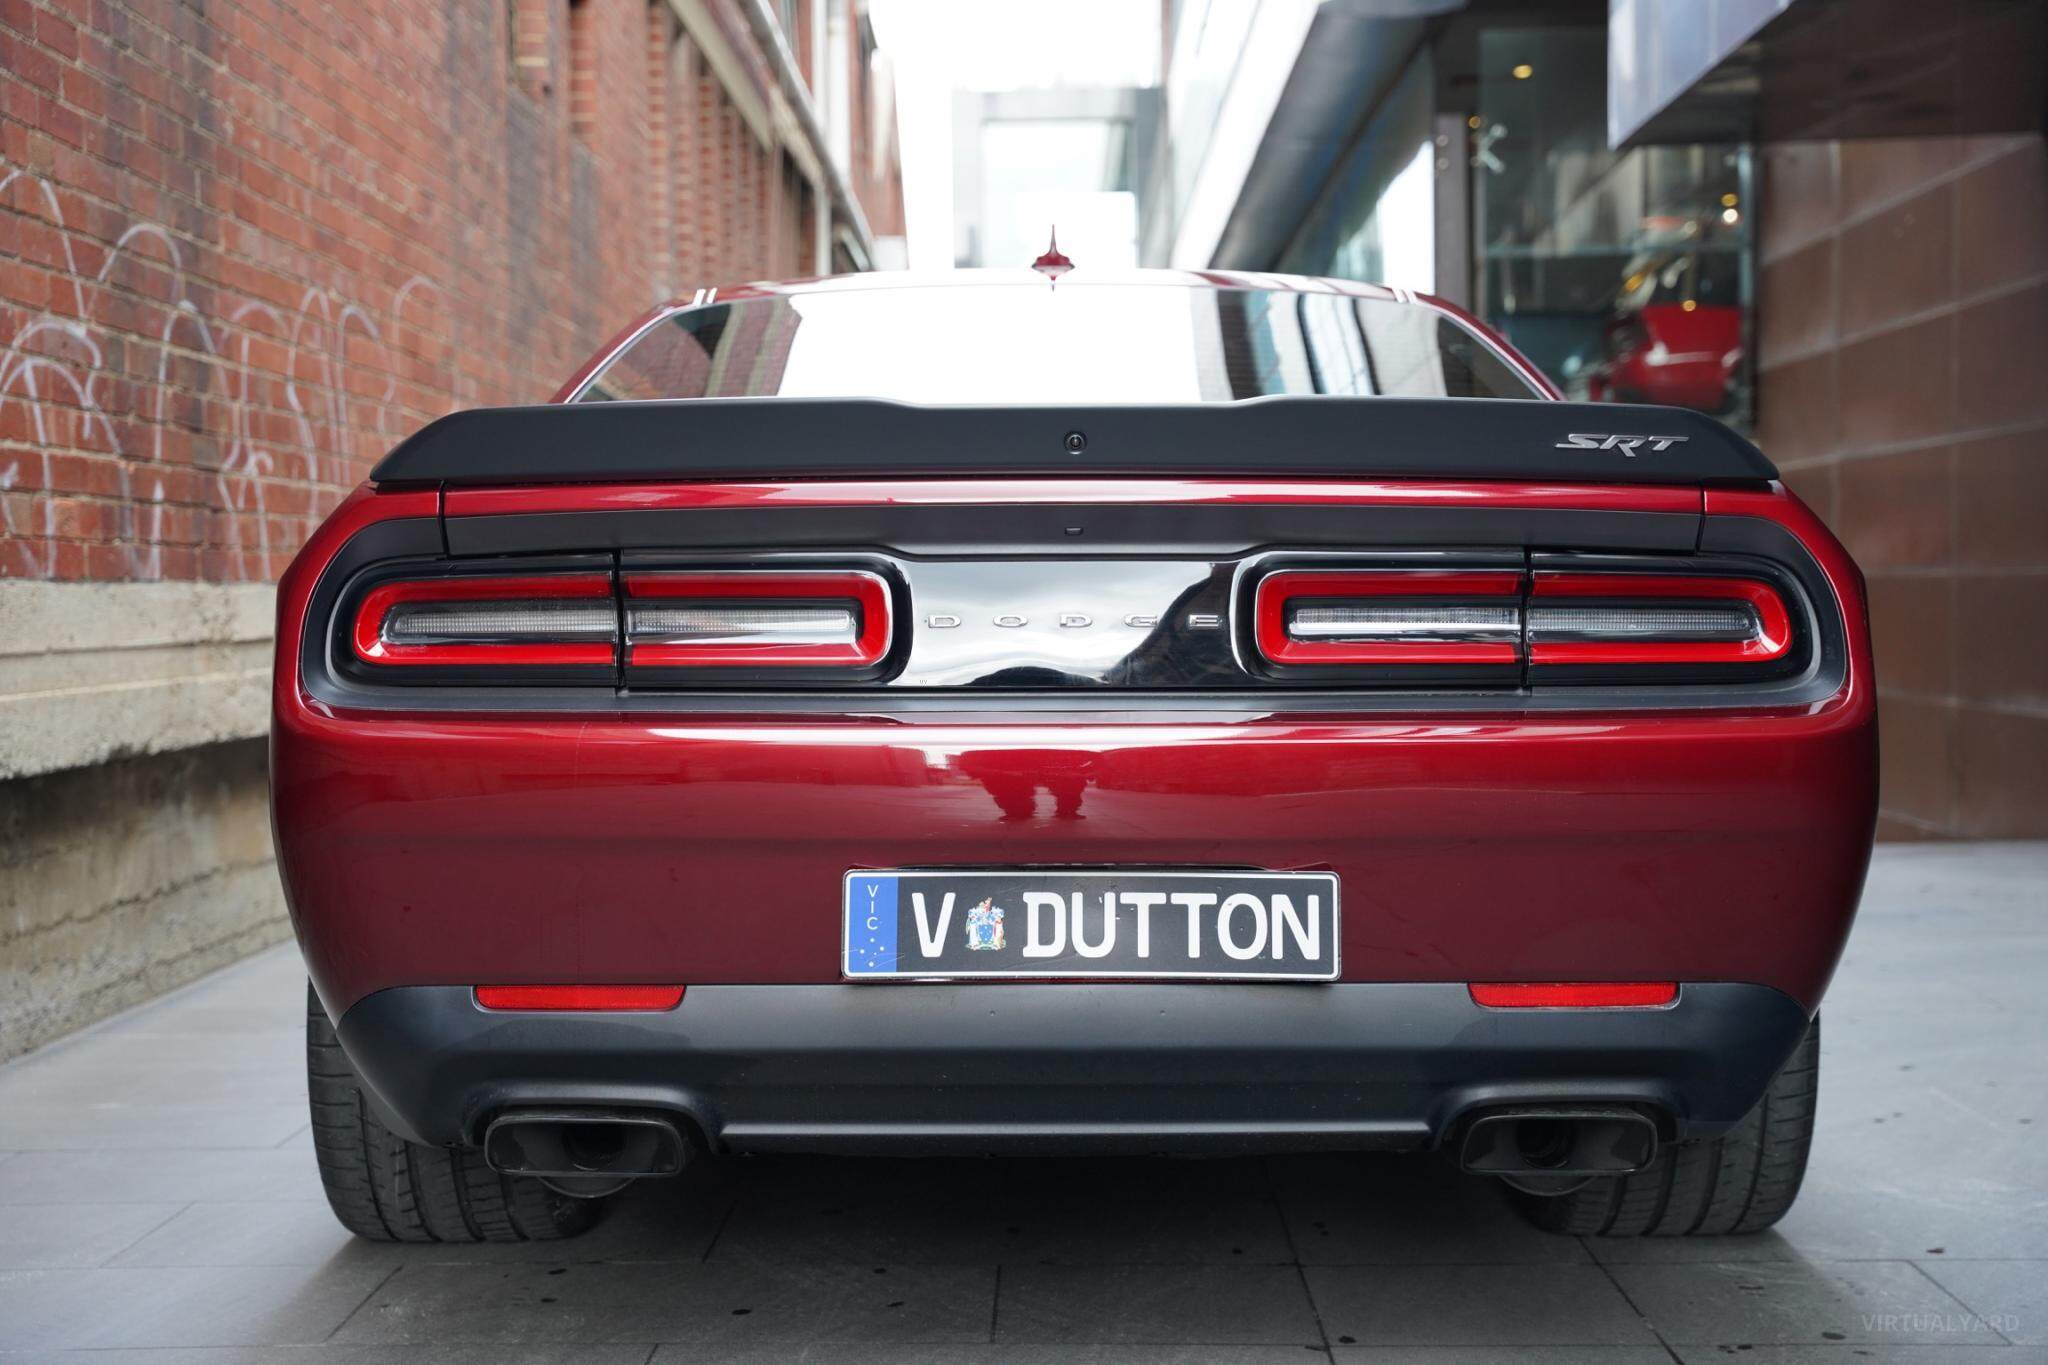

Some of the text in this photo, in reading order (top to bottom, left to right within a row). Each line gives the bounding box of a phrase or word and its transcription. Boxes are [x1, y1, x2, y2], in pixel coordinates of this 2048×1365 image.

[1555, 433, 1690, 458] SRT
[927, 614, 1219, 629] DODGE
[866, 884, 879, 931] VIC
[911, 891, 1321, 961] V DUTTON
